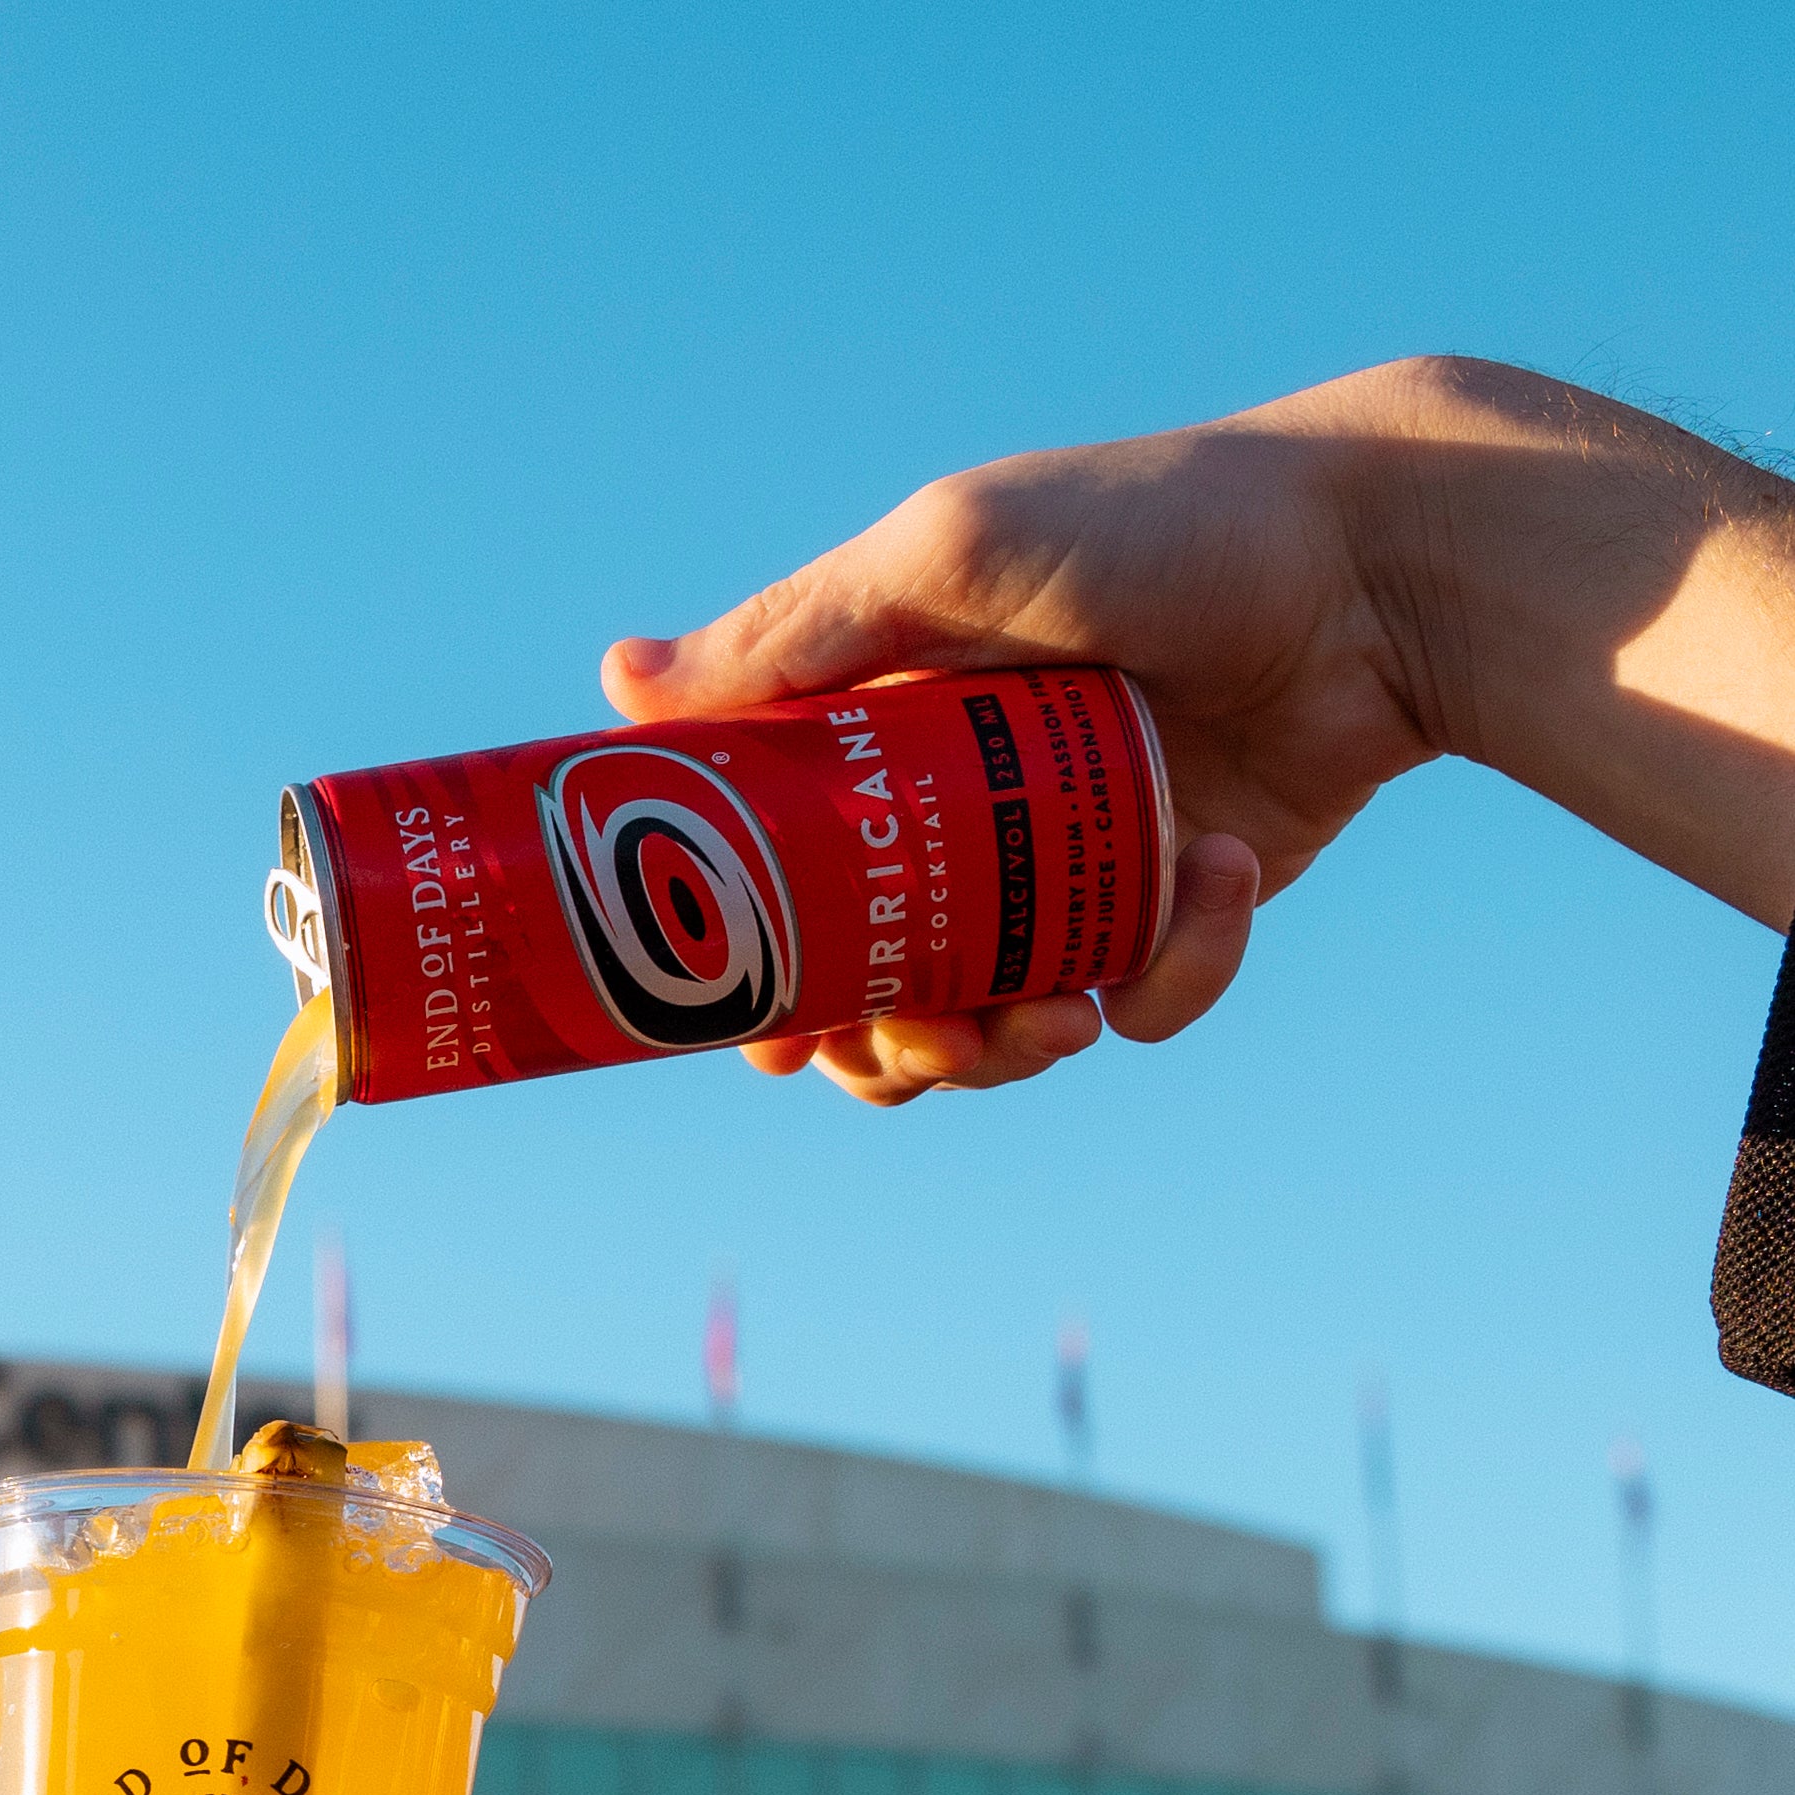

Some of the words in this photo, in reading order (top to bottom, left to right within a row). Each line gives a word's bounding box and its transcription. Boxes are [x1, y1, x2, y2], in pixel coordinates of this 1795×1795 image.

[973, 698, 999, 725] ML
[1039, 703, 1078, 794] PASSION
[988, 736, 1016, 782] 250
[1059, 679, 1113, 833] CARBONATION
[395, 806, 447, 914] DAYS
[827, 706, 907, 1023] HURRICANE
[915, 773, 949, 951] COCKTAIL
[1002, 808, 1029, 938] ALC/VOL
[1066, 821, 1085, 877] RUM
[1065, 886, 1086, 953] ENTRY
[1098, 859, 1116, 924] JUICE
[416, 924, 454, 978] OF
[444, 814, 492, 1054] DISTILLERY
[1059, 958, 1077, 977] OF
[425, 988, 459, 1071] END
[179, 1738, 254, 1777] OF
